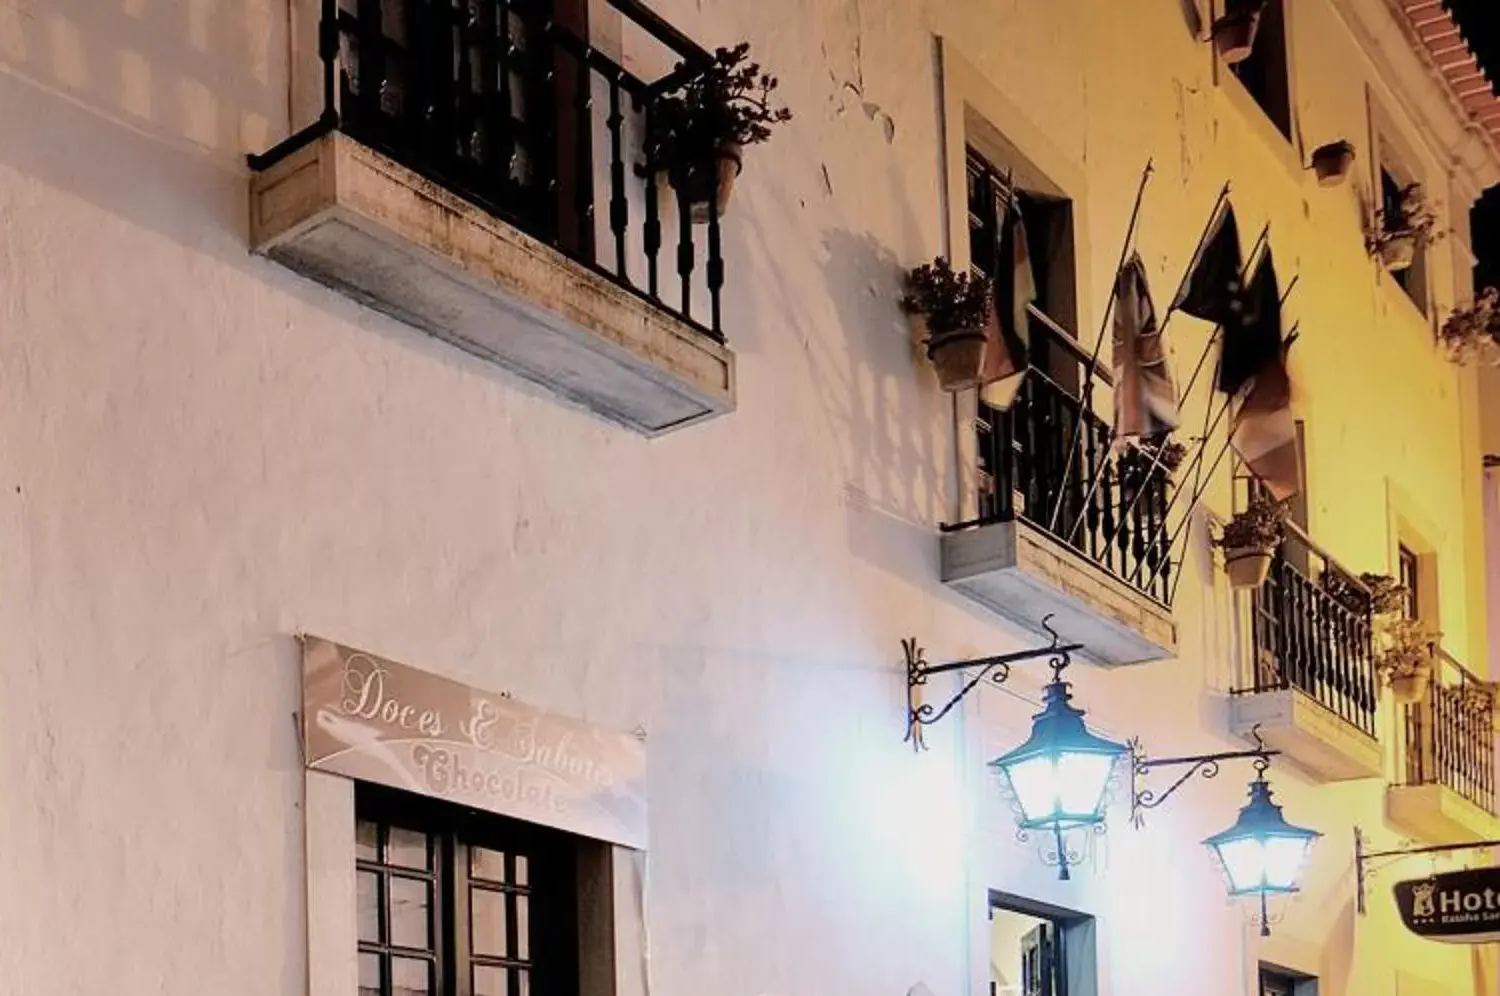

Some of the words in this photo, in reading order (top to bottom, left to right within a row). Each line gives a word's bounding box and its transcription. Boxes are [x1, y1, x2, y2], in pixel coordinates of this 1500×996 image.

[342, 653, 445, 737] Doces
[459, 699, 499, 749] &
[412, 745, 569, 813] Chocolate
[1440, 888, 1500, 912] Hot
